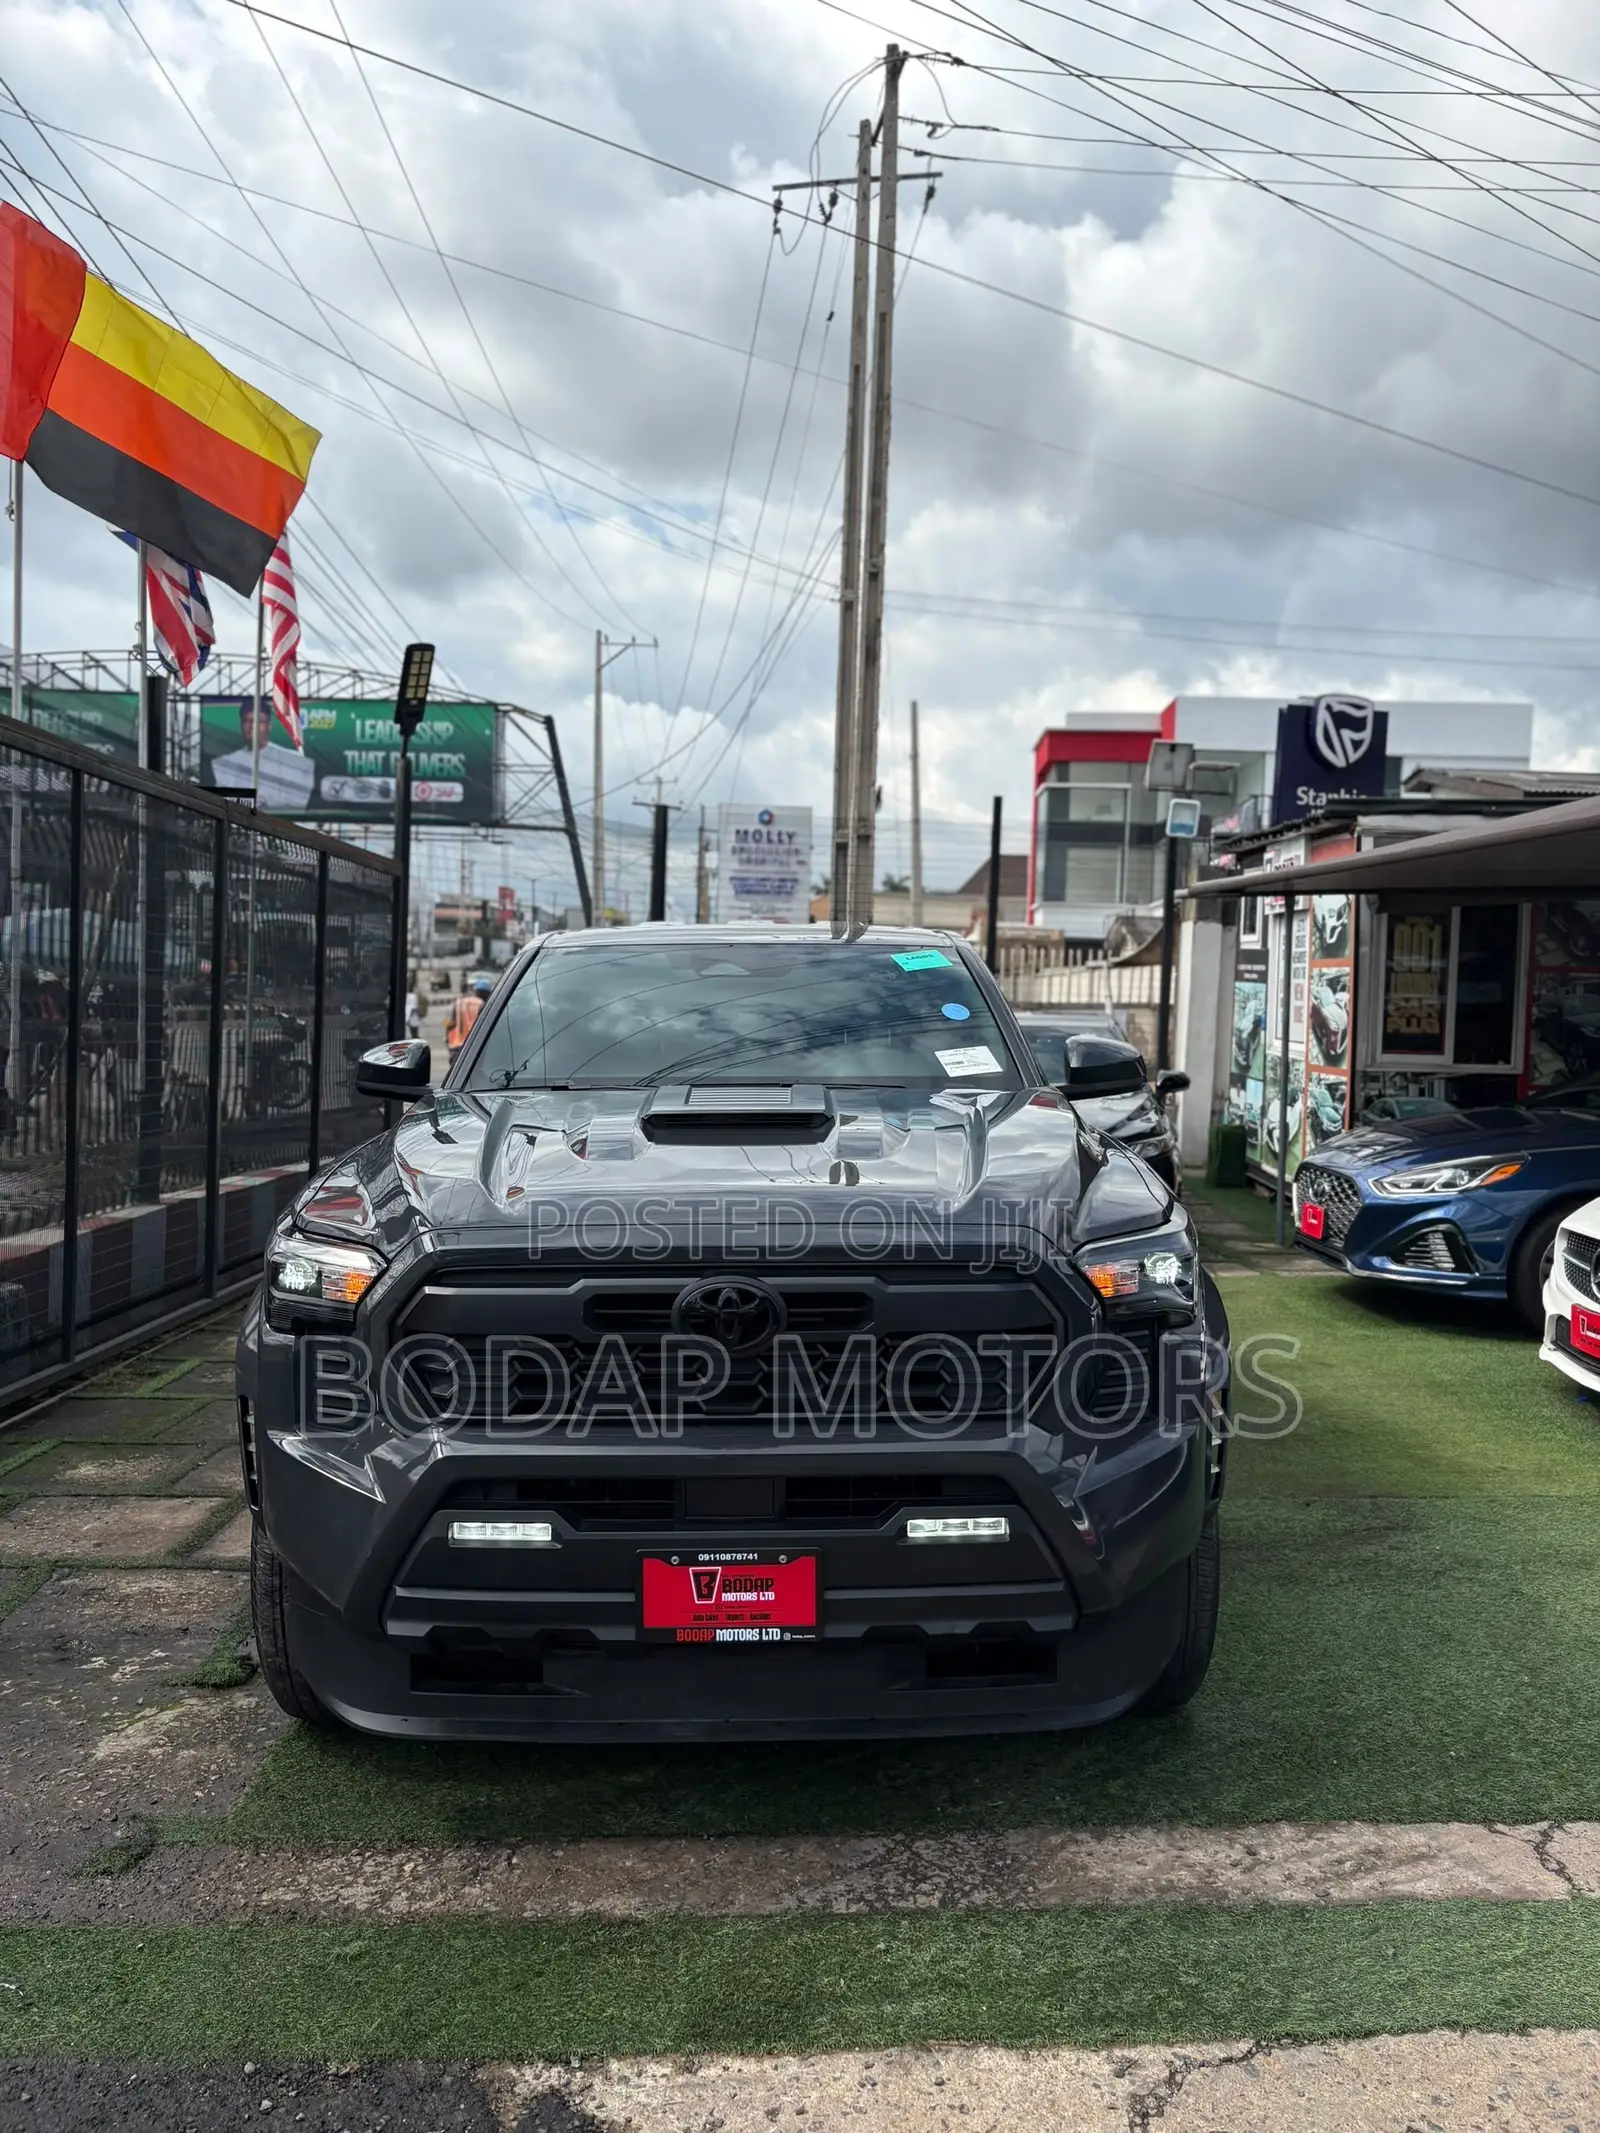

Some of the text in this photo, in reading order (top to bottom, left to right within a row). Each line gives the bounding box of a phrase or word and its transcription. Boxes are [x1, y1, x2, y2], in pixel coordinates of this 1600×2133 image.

[355, 719, 454, 745] LEADSHIP
[343, 750, 466, 777] THAT DLIVERS
[735, 829, 796, 845] MOLLY
[698, 1553, 758, 1561] 09110878741
[722, 1578, 775, 1593] BODAP
[721, 1592, 775, 1602] MOTORS LTD
[676, 1629, 715, 1642] BODAP
[716, 1628, 760, 1642] MOTORS
[762, 1628, 781, 1641] LTD
